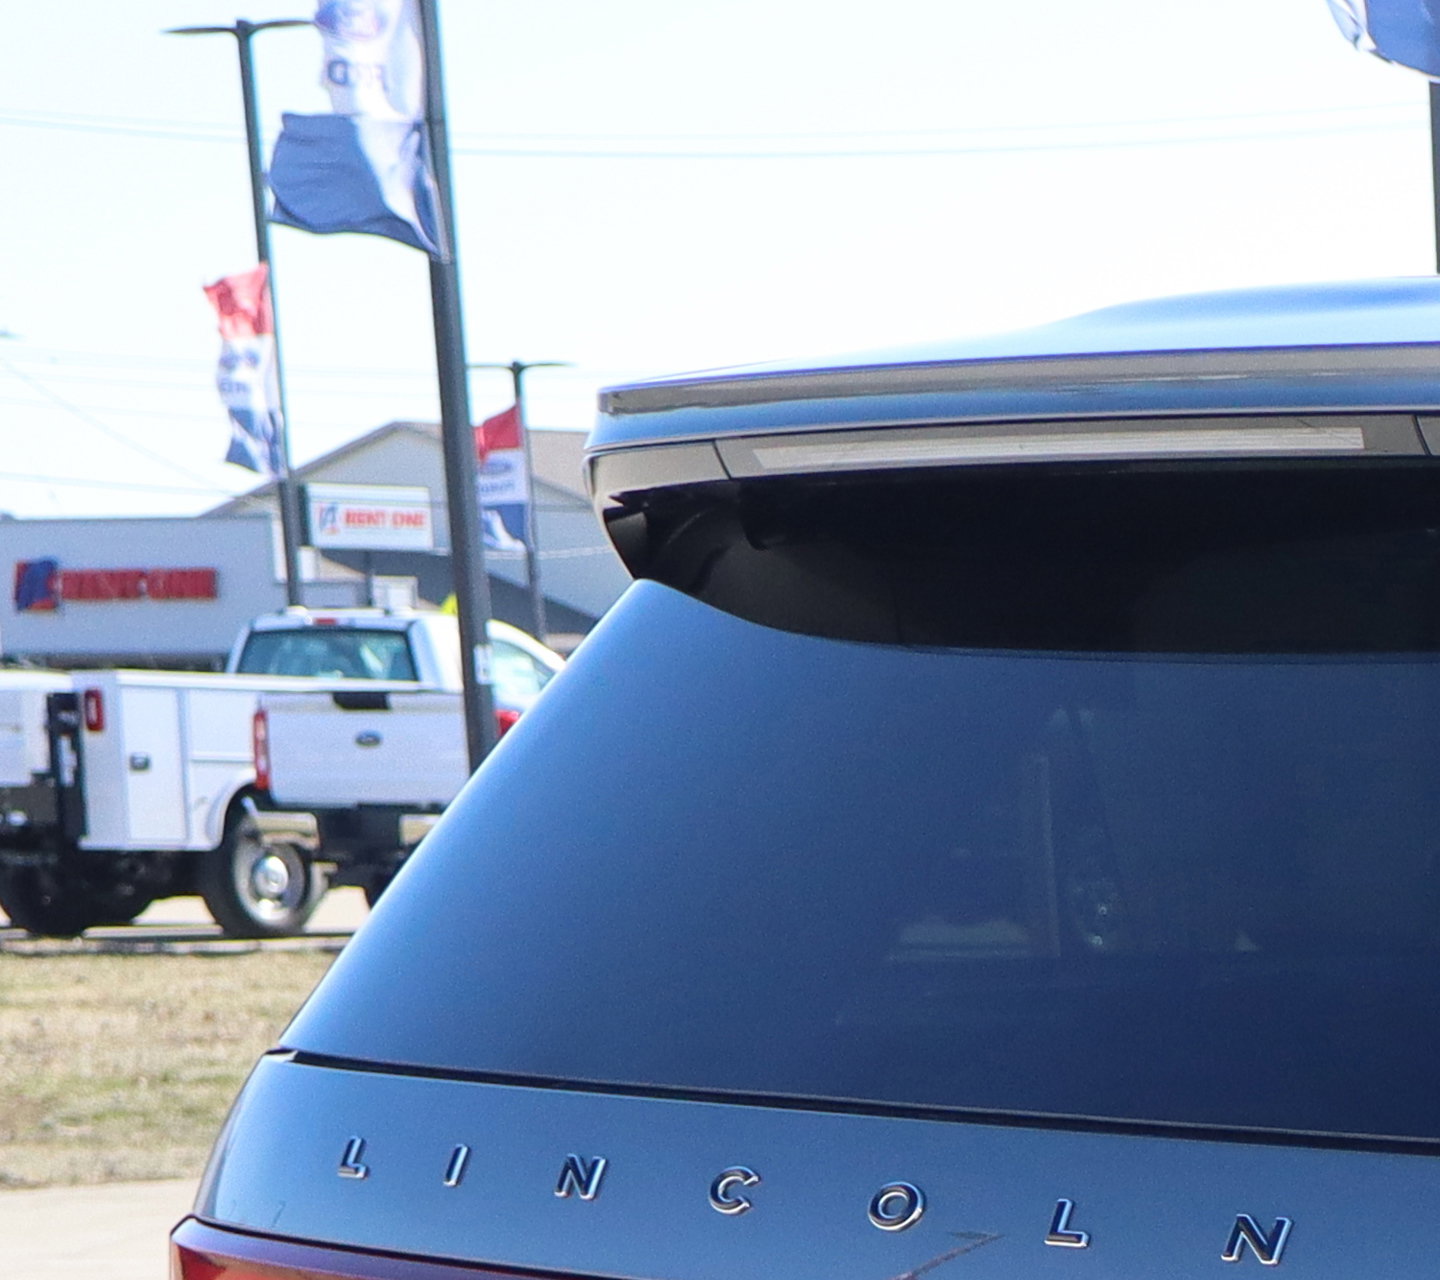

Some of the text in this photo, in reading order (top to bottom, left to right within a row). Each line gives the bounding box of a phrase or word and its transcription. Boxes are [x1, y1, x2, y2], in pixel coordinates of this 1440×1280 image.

[345, 509, 425, 529] RENT ONE
[337, 1135, 1294, 1266] LINCOLN
